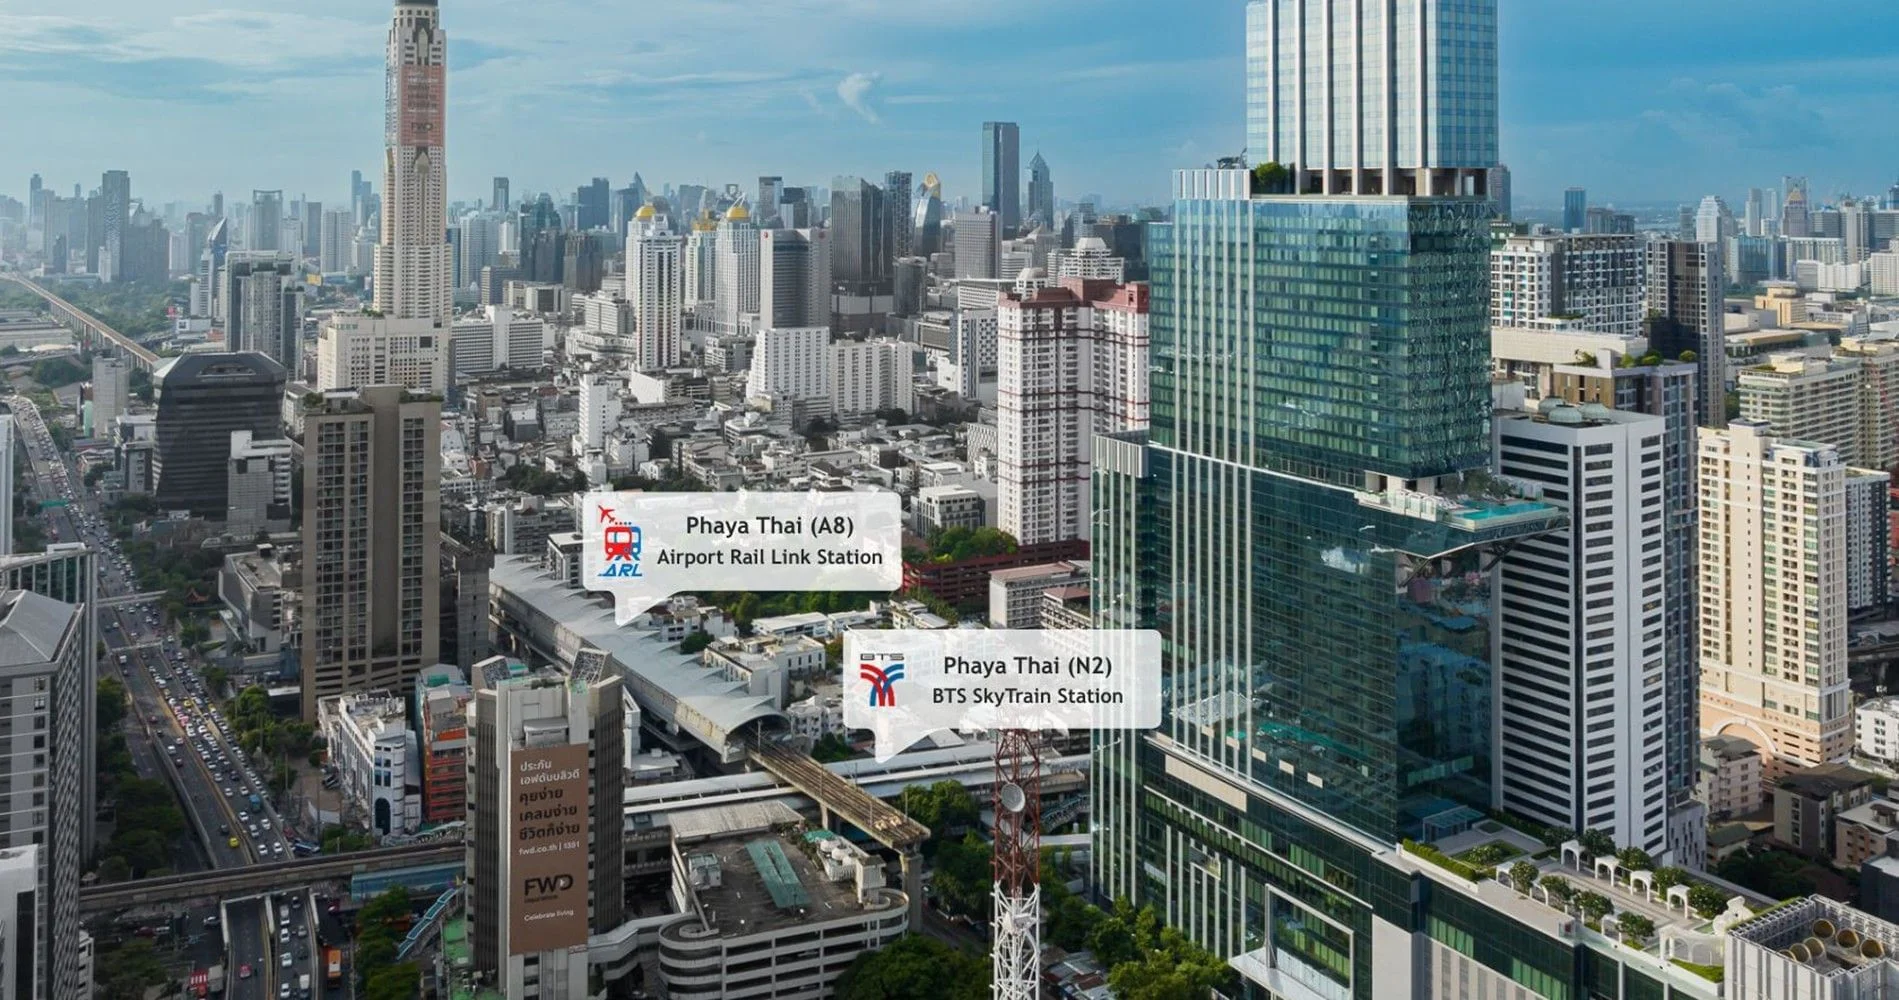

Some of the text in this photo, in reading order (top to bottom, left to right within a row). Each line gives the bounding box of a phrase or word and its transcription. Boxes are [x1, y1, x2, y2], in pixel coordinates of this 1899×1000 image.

[520, 787, 563, 805] คุยง่าย
[520, 804, 578, 821] เคลมง่าย
[524, 874, 573, 896] FWD
